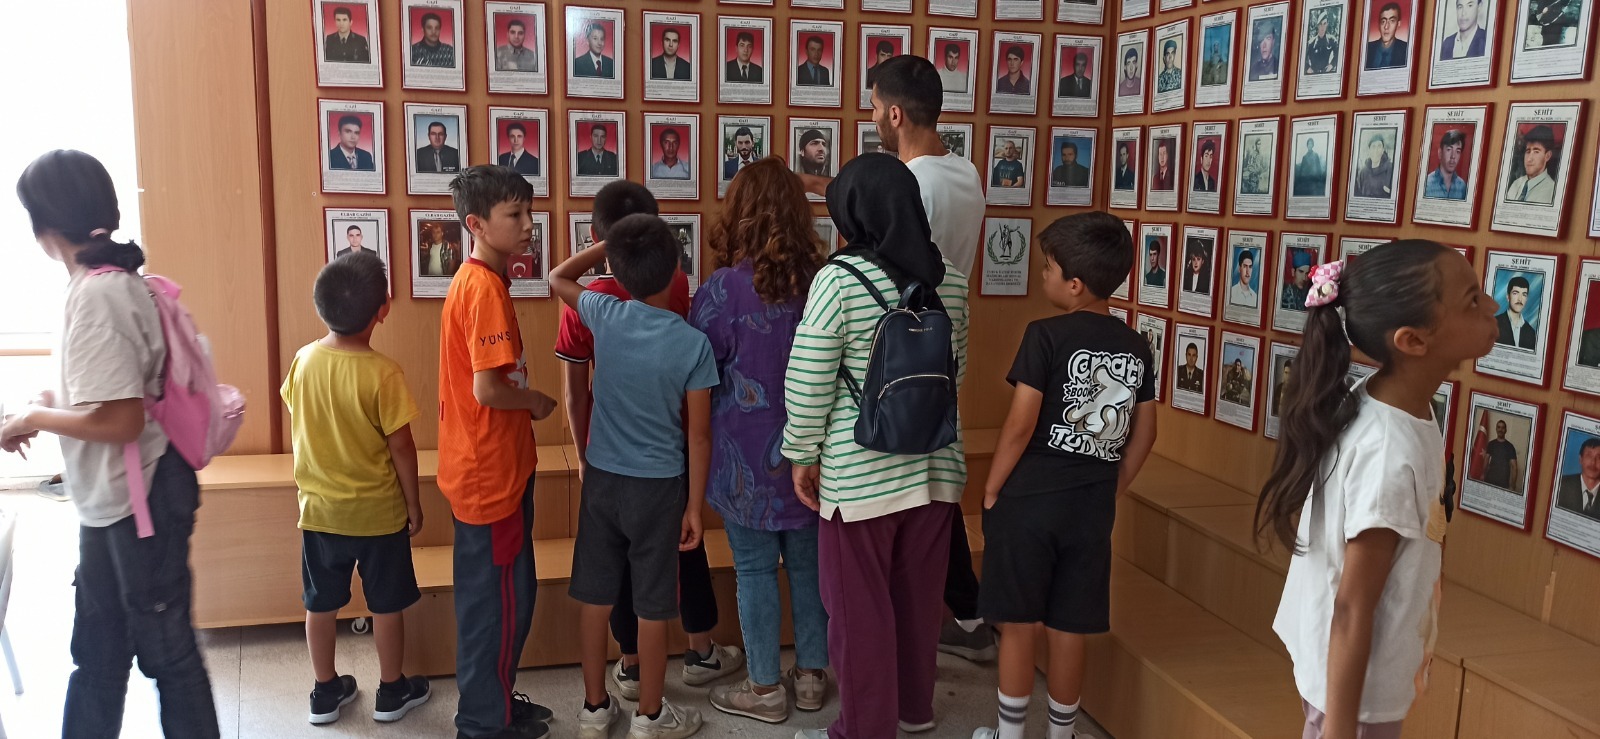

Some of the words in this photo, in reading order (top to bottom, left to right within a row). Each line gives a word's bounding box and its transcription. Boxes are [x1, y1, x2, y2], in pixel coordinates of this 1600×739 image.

[1534, 108, 1553, 116] ŞEHİT
[1512, 257, 1531, 266] ŞEHİT
[480, 332, 511, 346] YÜNS
